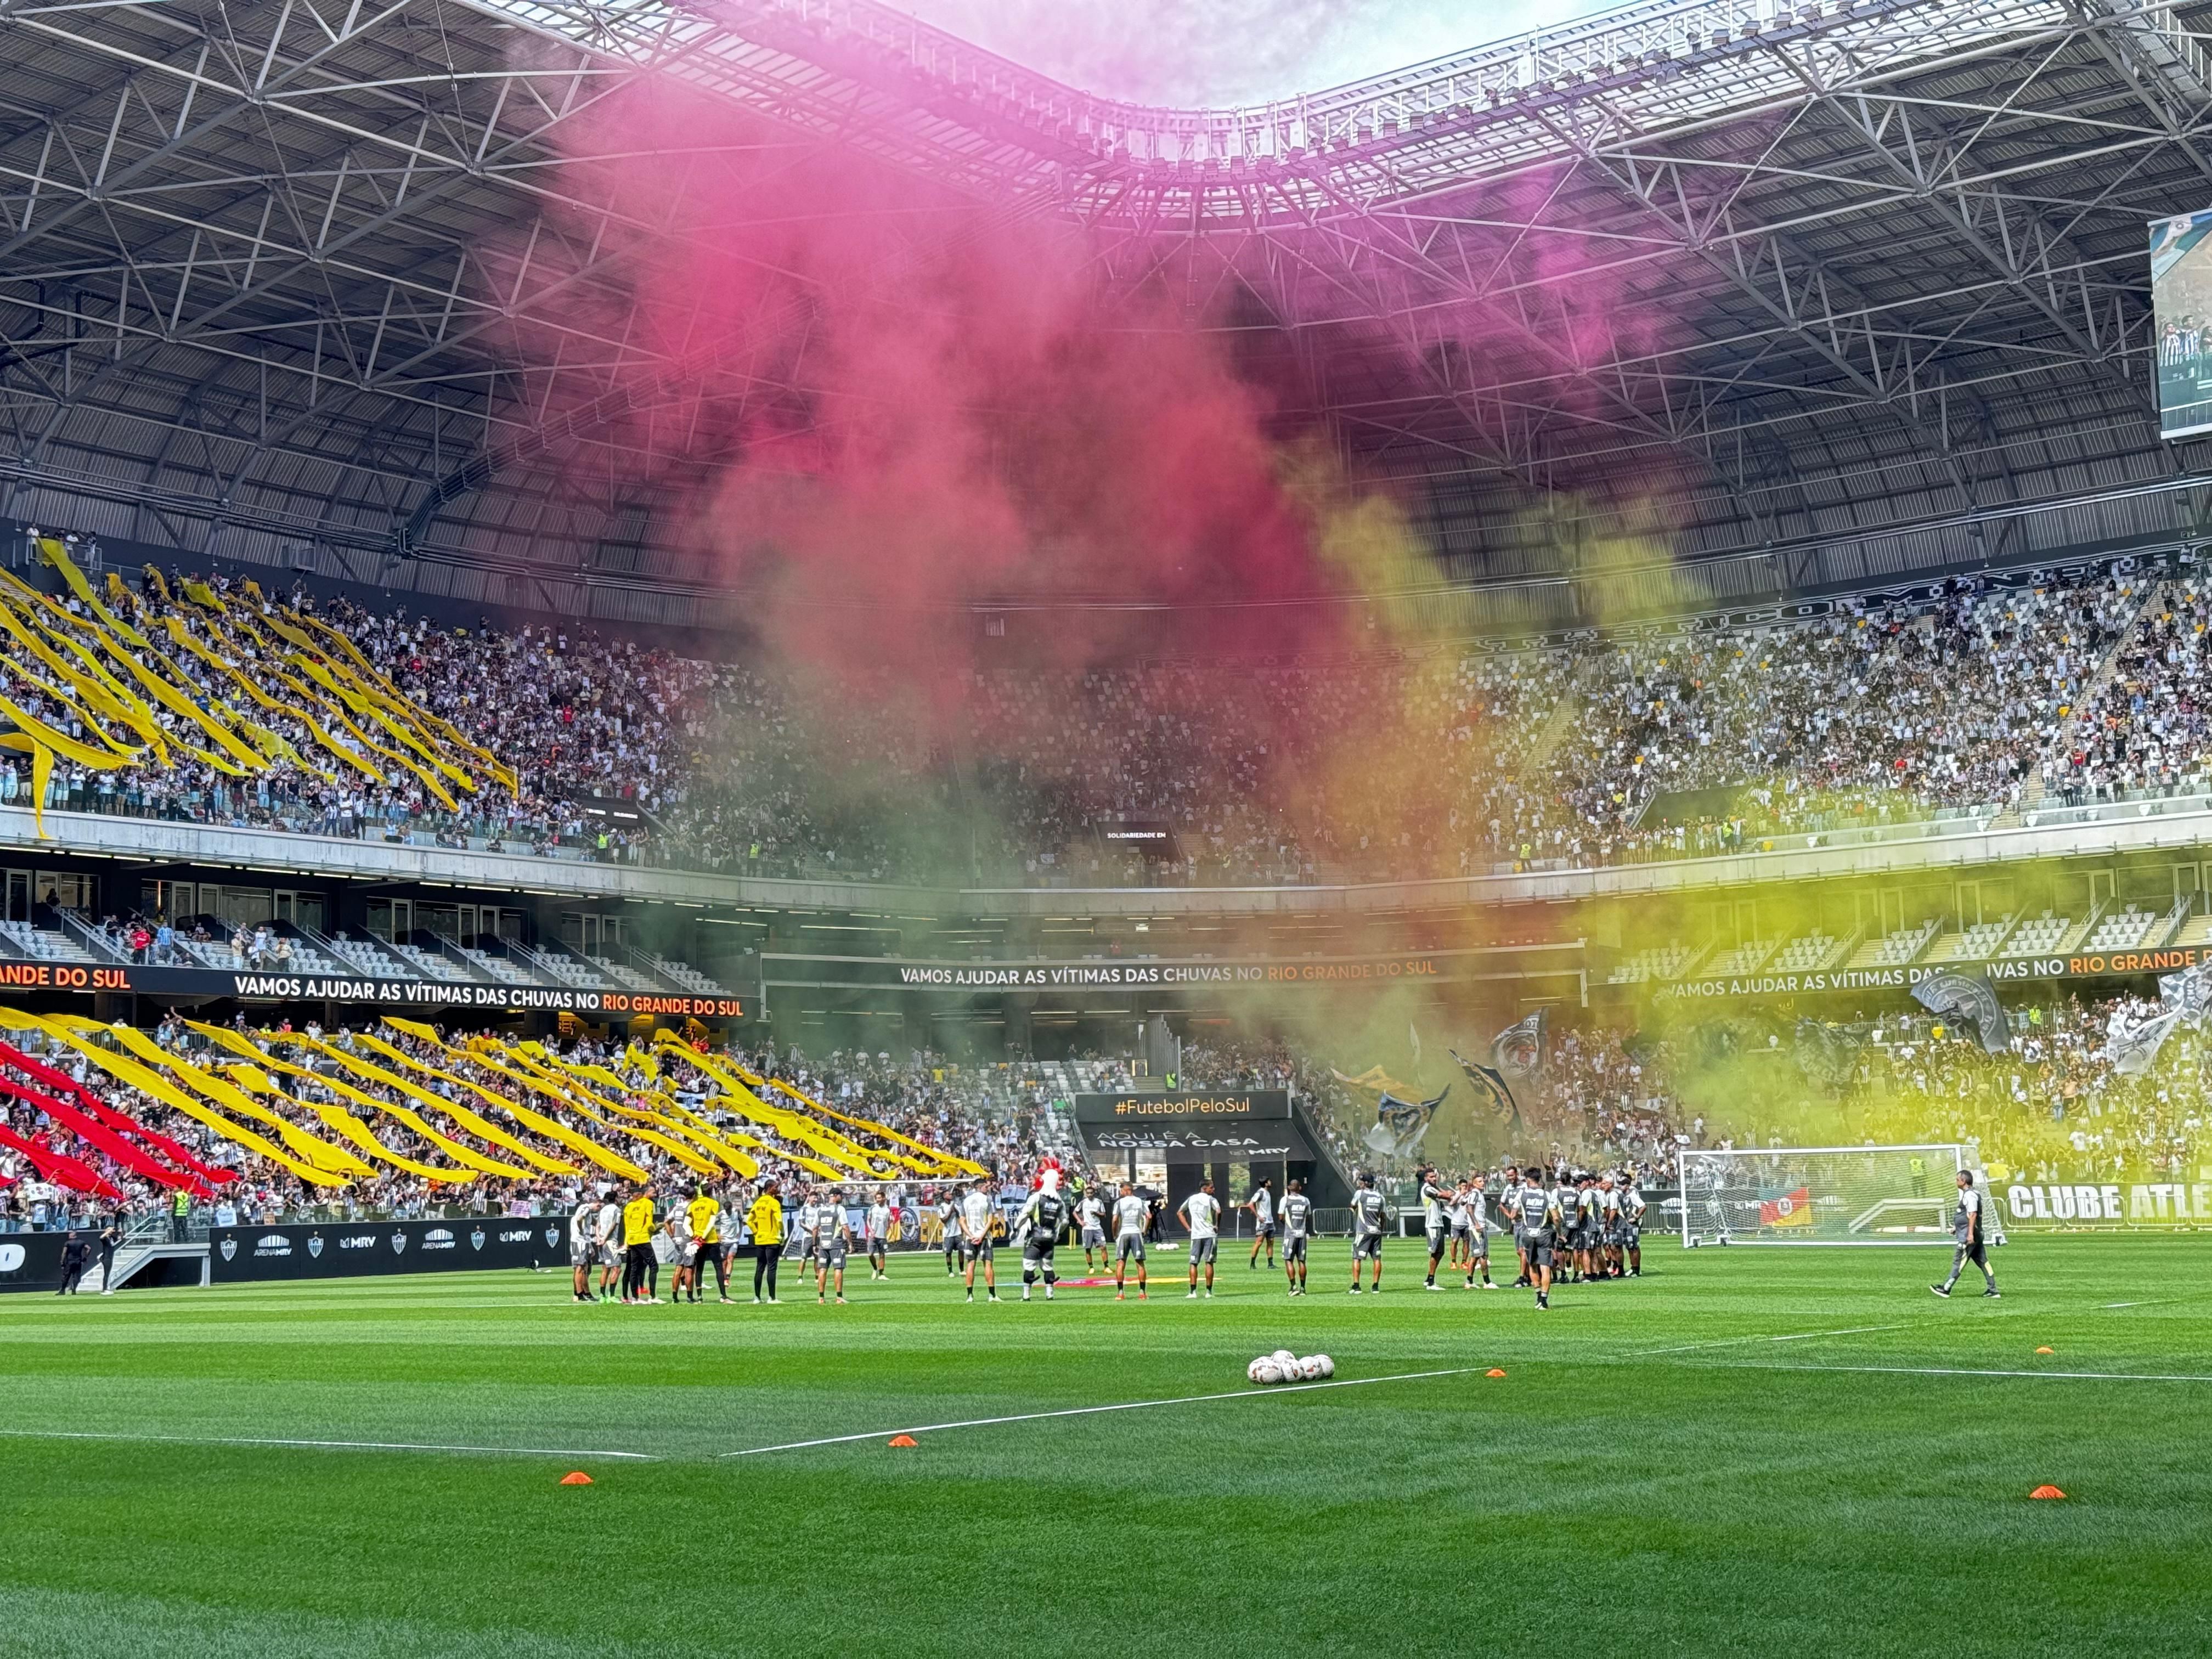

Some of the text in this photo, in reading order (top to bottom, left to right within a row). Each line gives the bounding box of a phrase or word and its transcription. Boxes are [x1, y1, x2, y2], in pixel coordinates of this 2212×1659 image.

[56, 968, 87, 986] DO
[93, 969, 131, 988] SUL
[901, 961, 1437, 984] VAMOS AJUDAR AS VÍTIMAS DAS CHUVAS NO RIO GRANDE DO SUL
[1730, 977, 1797, 994] AJUDAR
[1803, 974, 1825, 990] AS
[1830, 969, 1904, 988] VÍTIMAS
[2034, 959, 2064, 976] NO
[2070, 956, 2105, 974] RIO
[2111, 950, 2196, 971] GRANDE
[235, 977, 743, 1016] VAMOS AJUDAR AS VÍTIMAS DAS CHUVAS NO RIO GRANDE DO SUL
[1115, 1097, 1250, 1115] #FutebolPeloSul
[1192, 1138, 1260, 1147] CASA
[2008, 1185, 2123, 1219] CLUBE
[351, 1237, 376, 1248] MRV
[509, 1231, 532, 1242] MRV
